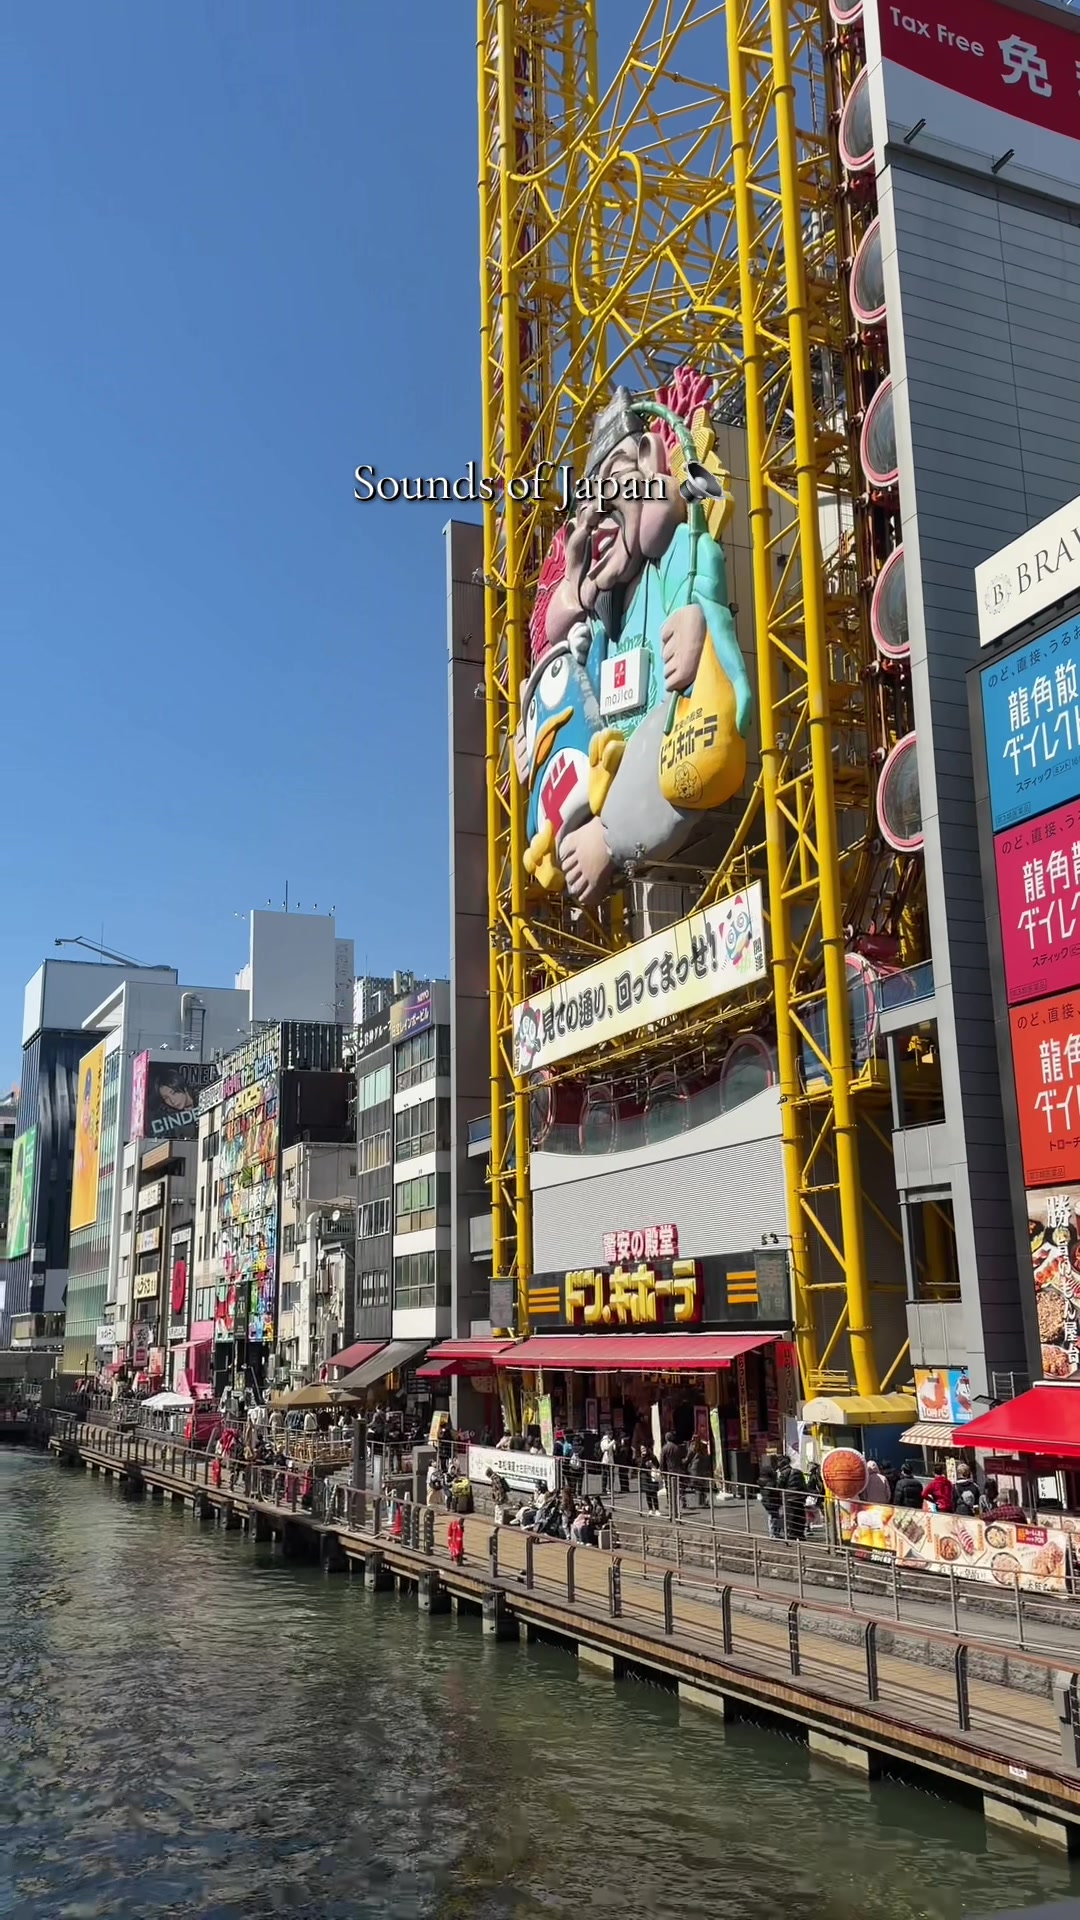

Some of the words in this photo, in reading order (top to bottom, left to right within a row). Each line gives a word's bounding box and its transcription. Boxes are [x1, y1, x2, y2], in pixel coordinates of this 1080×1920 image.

[890, 6, 931, 39] Tax
[937, 23, 985, 57] Free
[997, 34, 1080, 99] 免
[993, 583, 1005, 606] B
[605, 689, 634, 707] mojica
[1007, 659, 1079, 732] 龍角散
[1016, 767, 1052, 794] スティック
[1032, 946, 1069, 968] スティック
